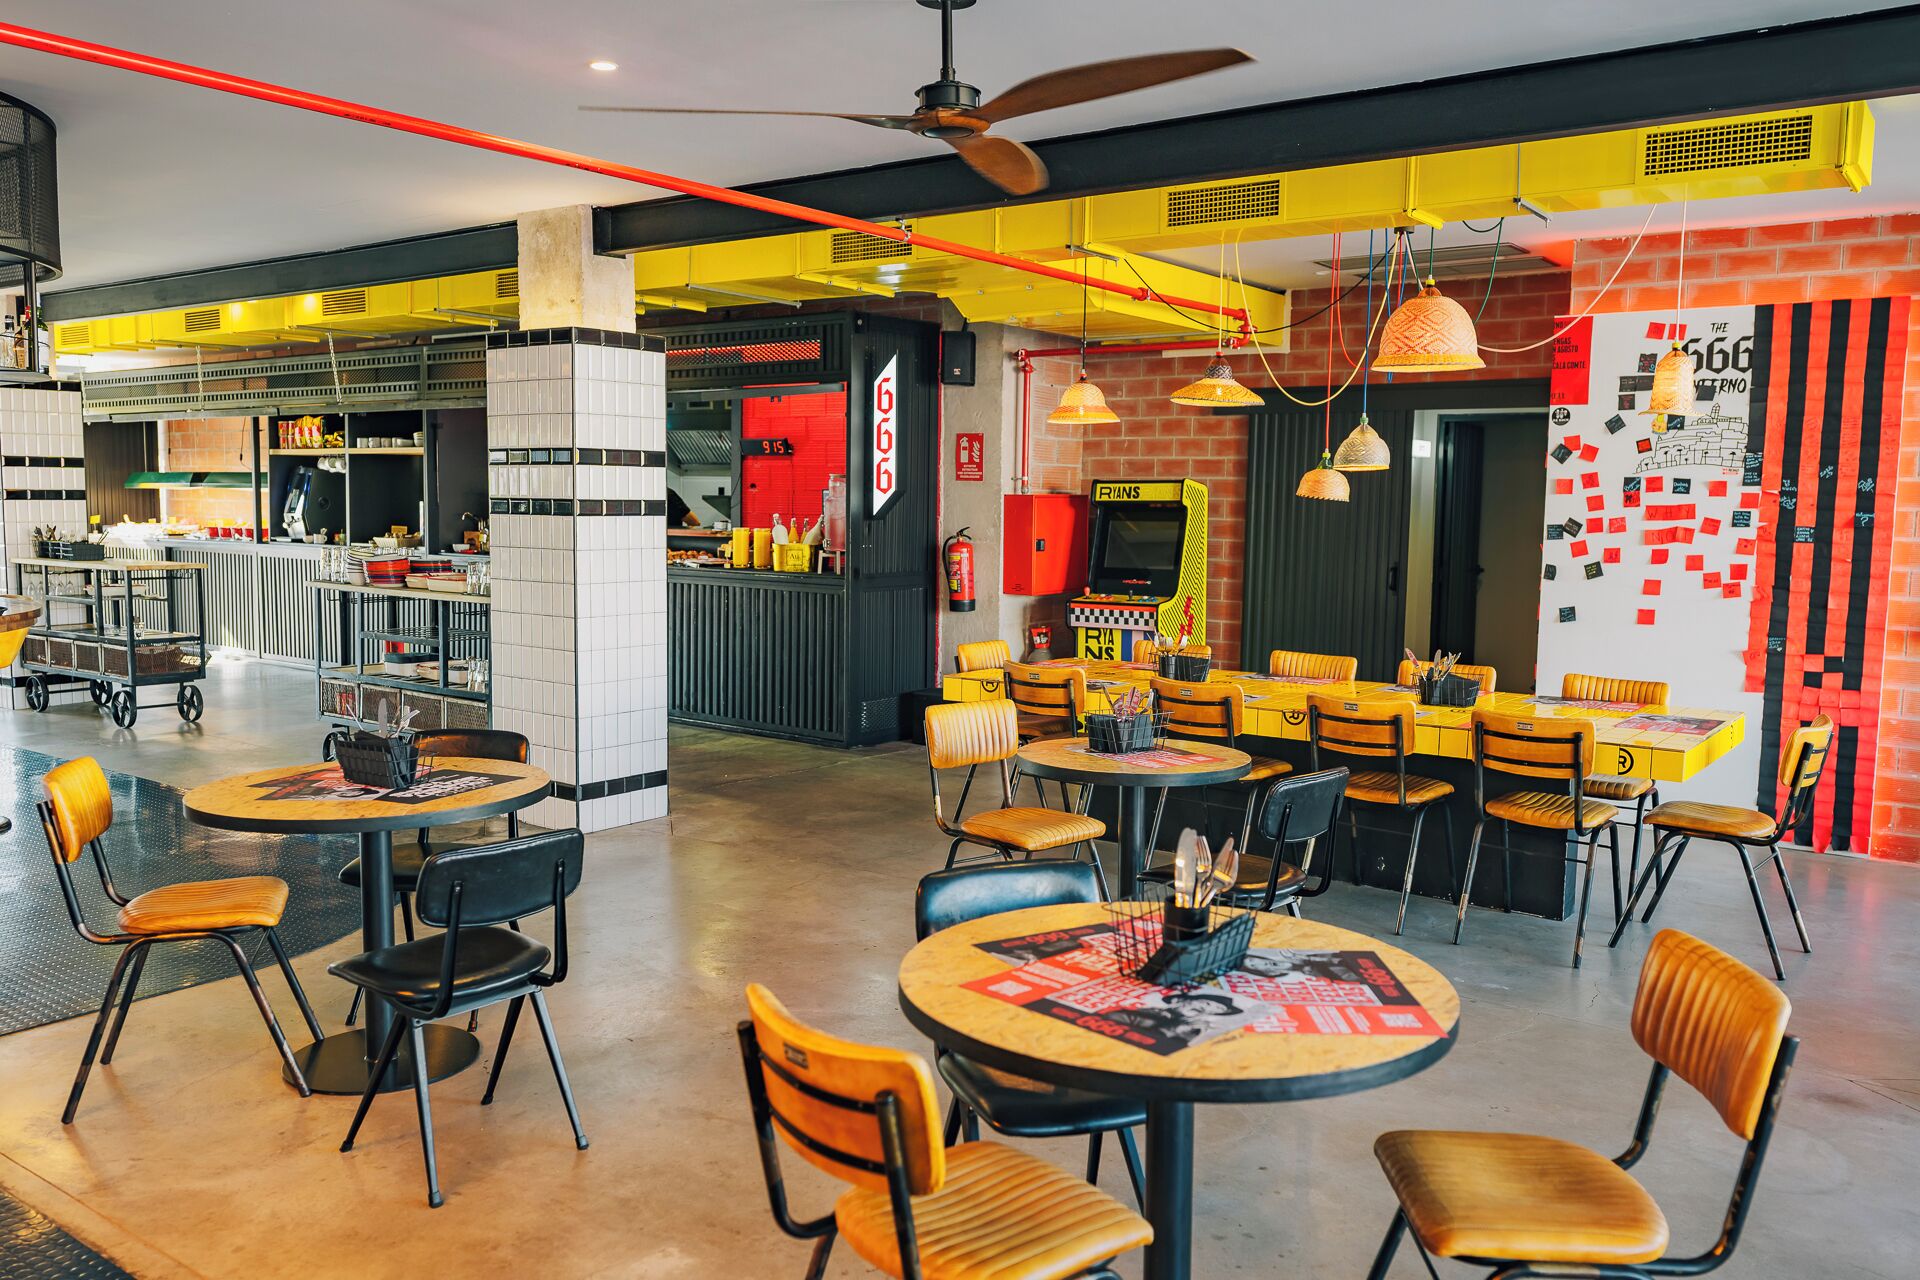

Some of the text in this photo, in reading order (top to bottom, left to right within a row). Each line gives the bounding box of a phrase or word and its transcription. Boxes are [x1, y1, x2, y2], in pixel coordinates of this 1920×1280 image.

[1711, 322, 1729, 334] THE
[1681, 335, 1754, 375] 666
[876, 377, 894, 495] 666
[1099, 485, 1141, 500] RYANS
[1647, 506, 1691, 519] WHY
